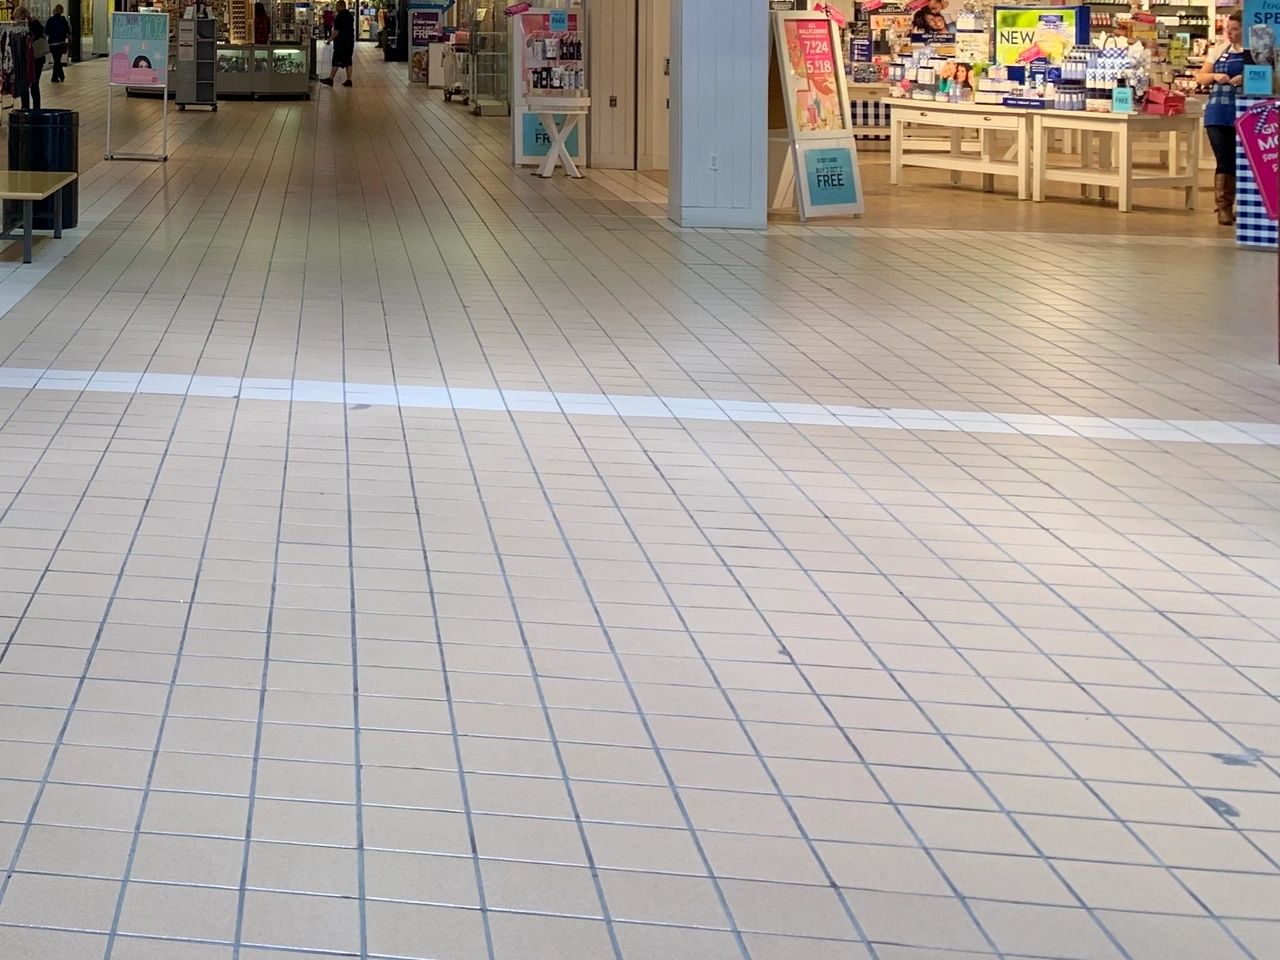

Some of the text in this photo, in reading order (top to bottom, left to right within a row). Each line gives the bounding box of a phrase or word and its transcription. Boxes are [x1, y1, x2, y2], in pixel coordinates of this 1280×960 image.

[1000, 31, 1035, 45] NEW
[803, 40, 811, 54] 7
[806, 60, 814, 74] 5
[816, 173, 845, 188] FREE
